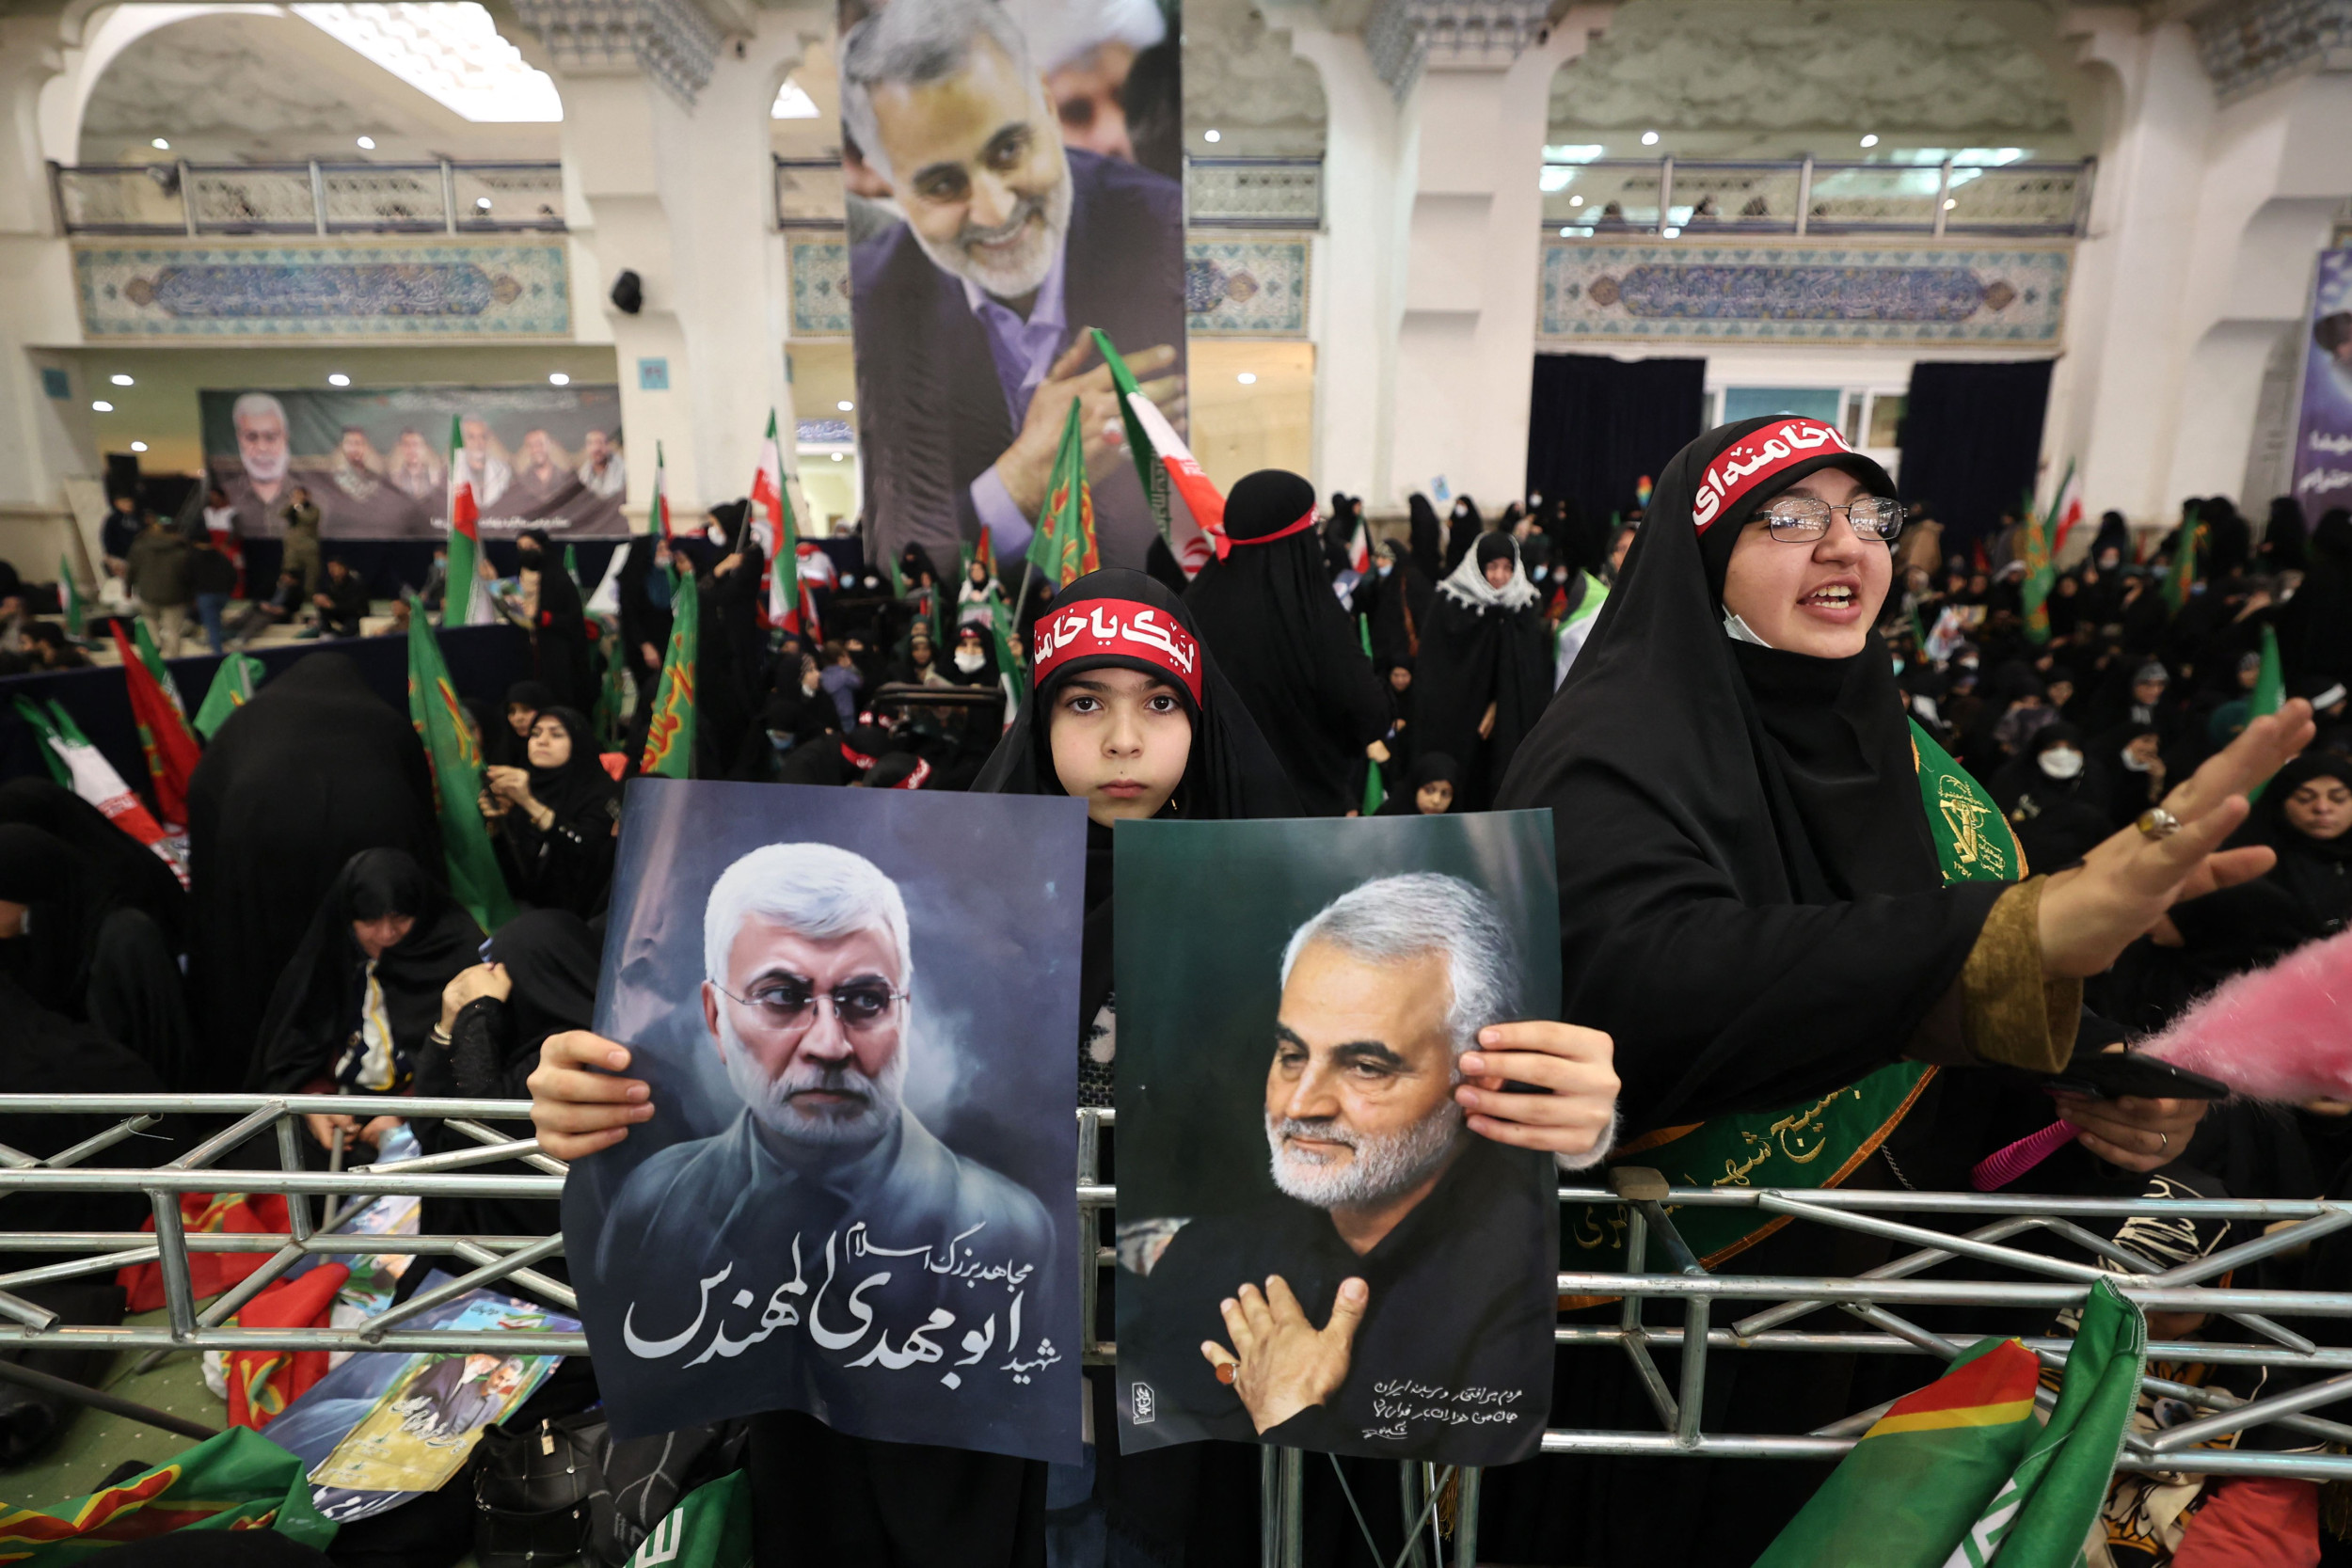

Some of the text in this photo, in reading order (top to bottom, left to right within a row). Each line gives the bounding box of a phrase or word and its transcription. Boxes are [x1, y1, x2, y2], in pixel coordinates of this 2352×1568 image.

[1089, 606, 1119, 646] یا
[846, 1221, 1034, 1293] مجاهد بزرگ اسلام
[623, 1230, 837, 1370] المهندس
[999, 1338, 1062, 1385] شهید
[1374, 1379, 1412, 1397] ایران
[1498, 1389, 1523, 1406] مردم
[1471, 1412, 1493, 1424] من
[1492, 1410, 1518, 1424] جان
